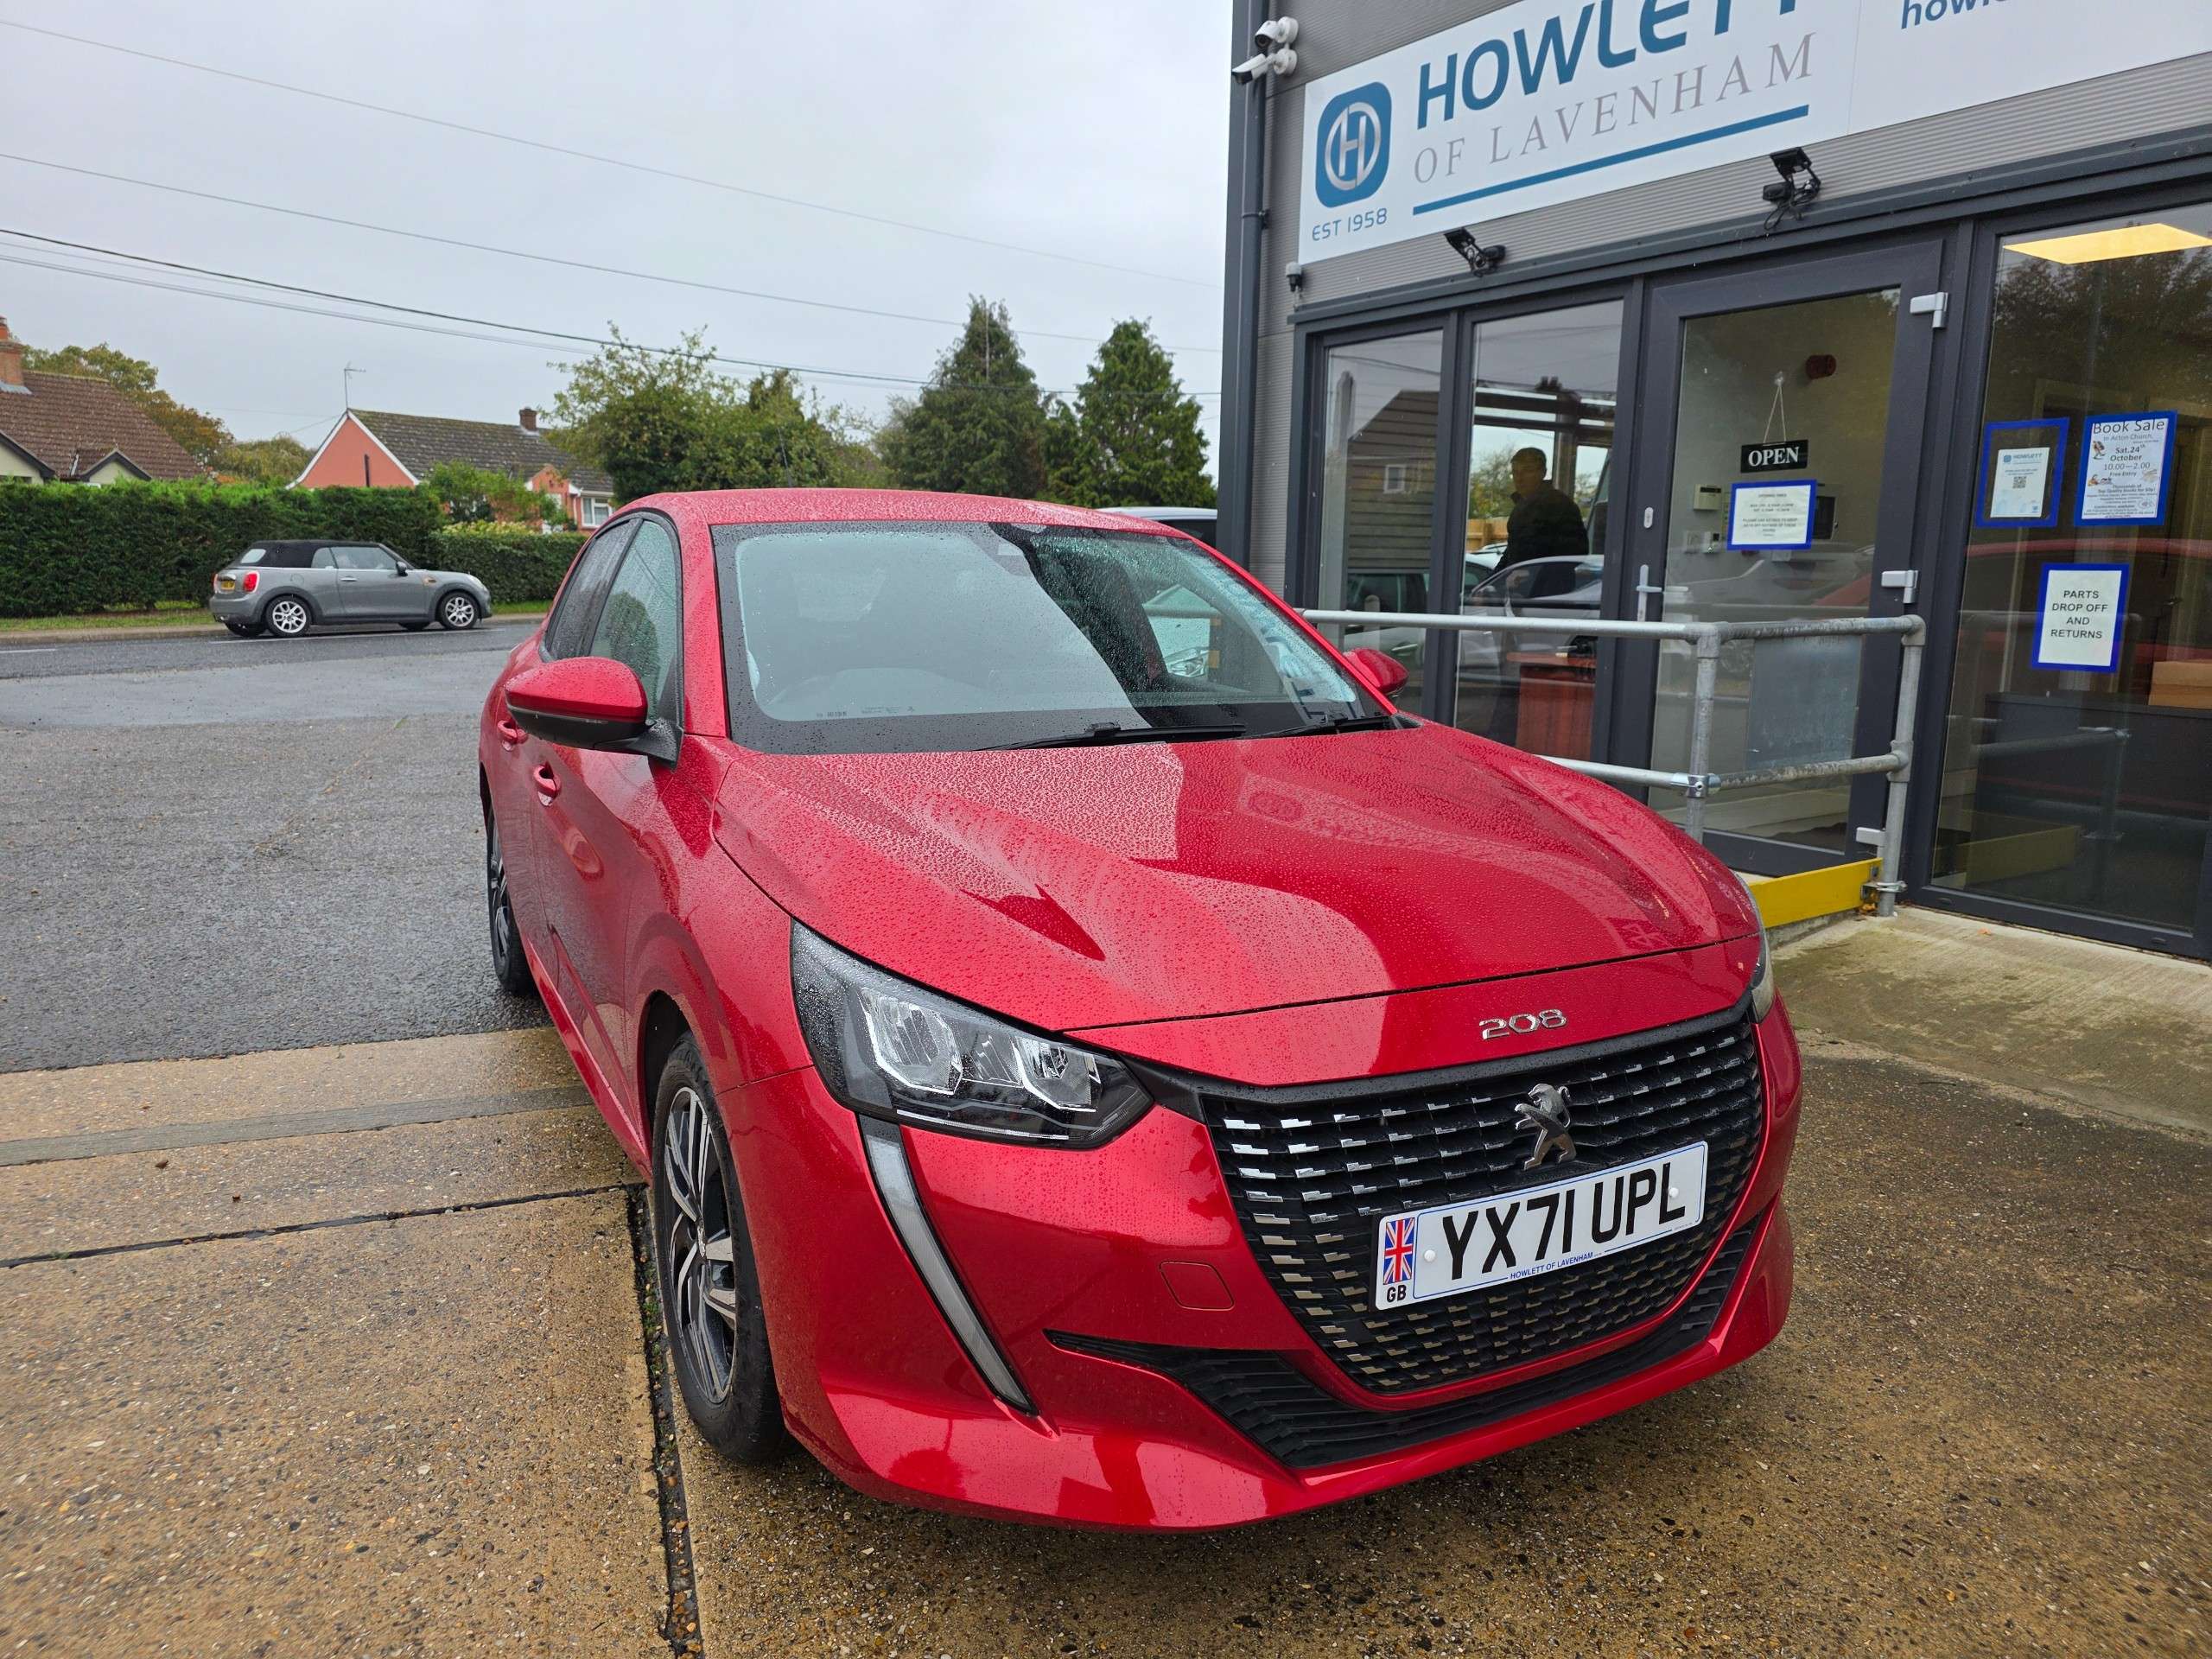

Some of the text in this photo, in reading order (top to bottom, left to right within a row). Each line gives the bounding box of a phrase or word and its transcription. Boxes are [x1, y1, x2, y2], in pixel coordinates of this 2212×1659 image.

[1414, 31, 1816, 184] OF LAVENHAM
[1312, 207, 1388, 242] EST 1958
[2094, 418, 2164, 434] Book Sale
[1748, 447, 1800, 467] OPEN
[2110, 454, 2142, 462] October
[2063, 590, 2100, 600] PARTS
[2052, 602, 2108, 613] DROP OFF
[2066, 616, 2090, 626] AND
[2050, 628, 2102, 639] RETURNS
[1478, 1008, 1568, 1040] 208
[1442, 1162, 1686, 1281] YX71 UPL
[1510, 1252, 1593, 1280] HOWLETT OF LAVENHAM
[1386, 1285, 1407, 1303] GB
